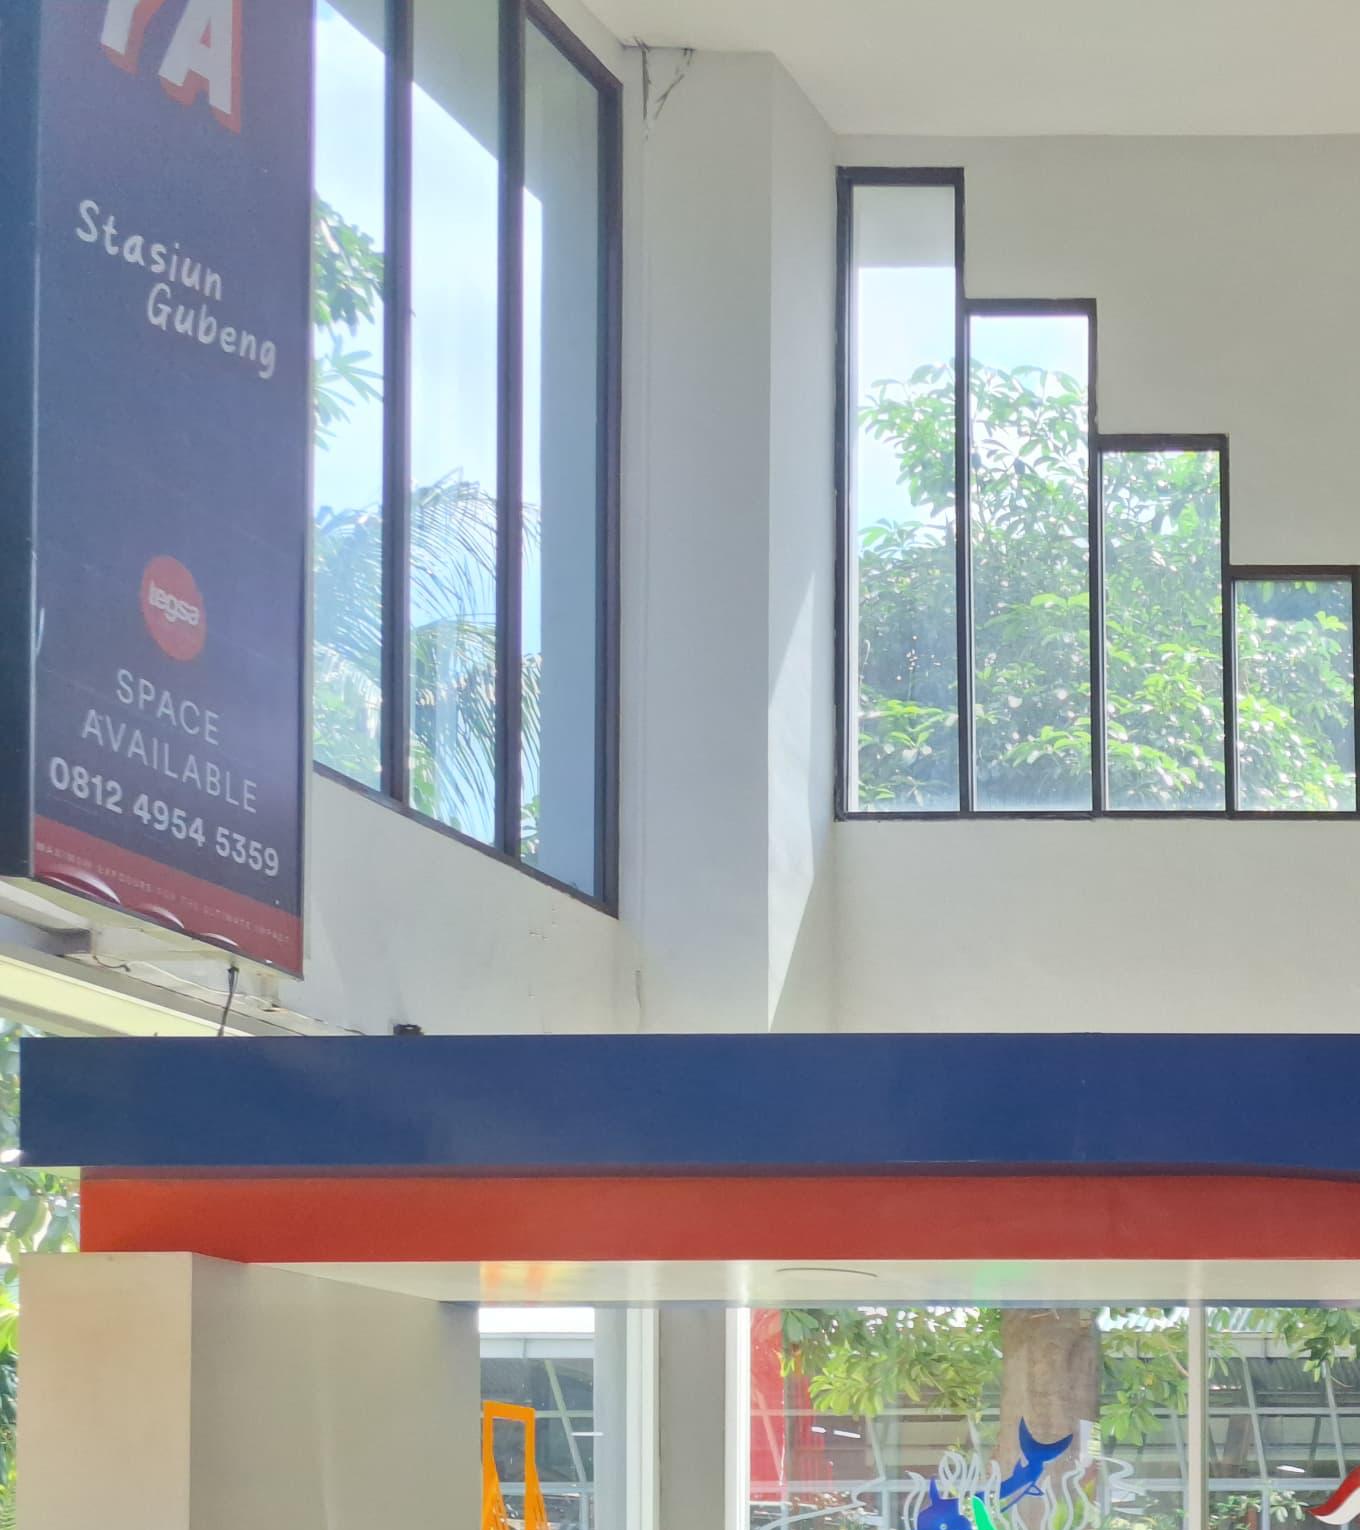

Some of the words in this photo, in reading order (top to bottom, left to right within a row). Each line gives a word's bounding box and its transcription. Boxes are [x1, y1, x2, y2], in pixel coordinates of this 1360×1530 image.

[76, 199, 222, 300] Stasiun
[147, 282, 276, 379] Gubeng
[116, 668, 219, 745] SPACE
[81, 709, 257, 813] AVAILABLE
[51, 757, 122, 814] 0812
[133, 794, 205, 847] 4954
[215, 826, 279, 877] 5359
